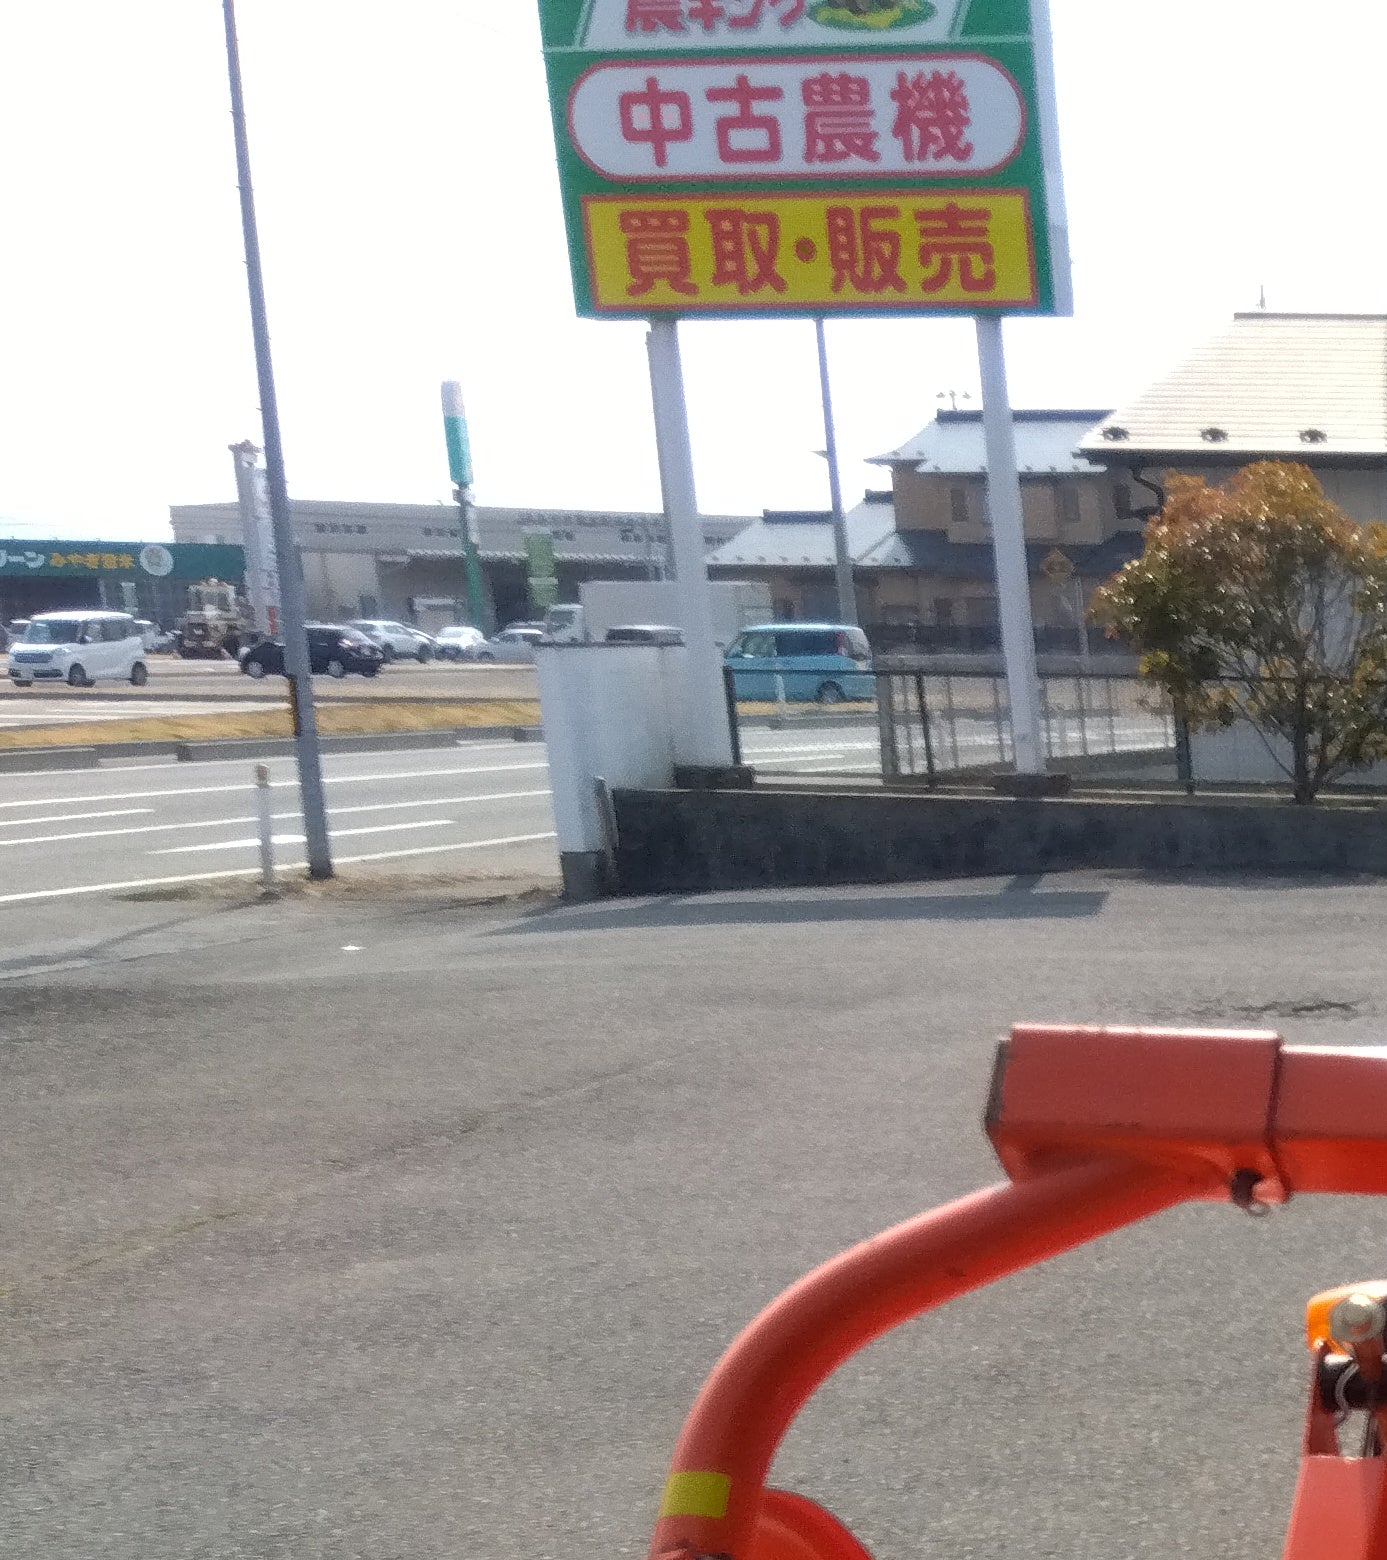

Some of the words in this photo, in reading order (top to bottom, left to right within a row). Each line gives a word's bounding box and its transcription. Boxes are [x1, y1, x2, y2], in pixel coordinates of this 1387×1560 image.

[618, 70, 974, 167] 中古農機
[617, 201, 997, 297] 買取・販売
